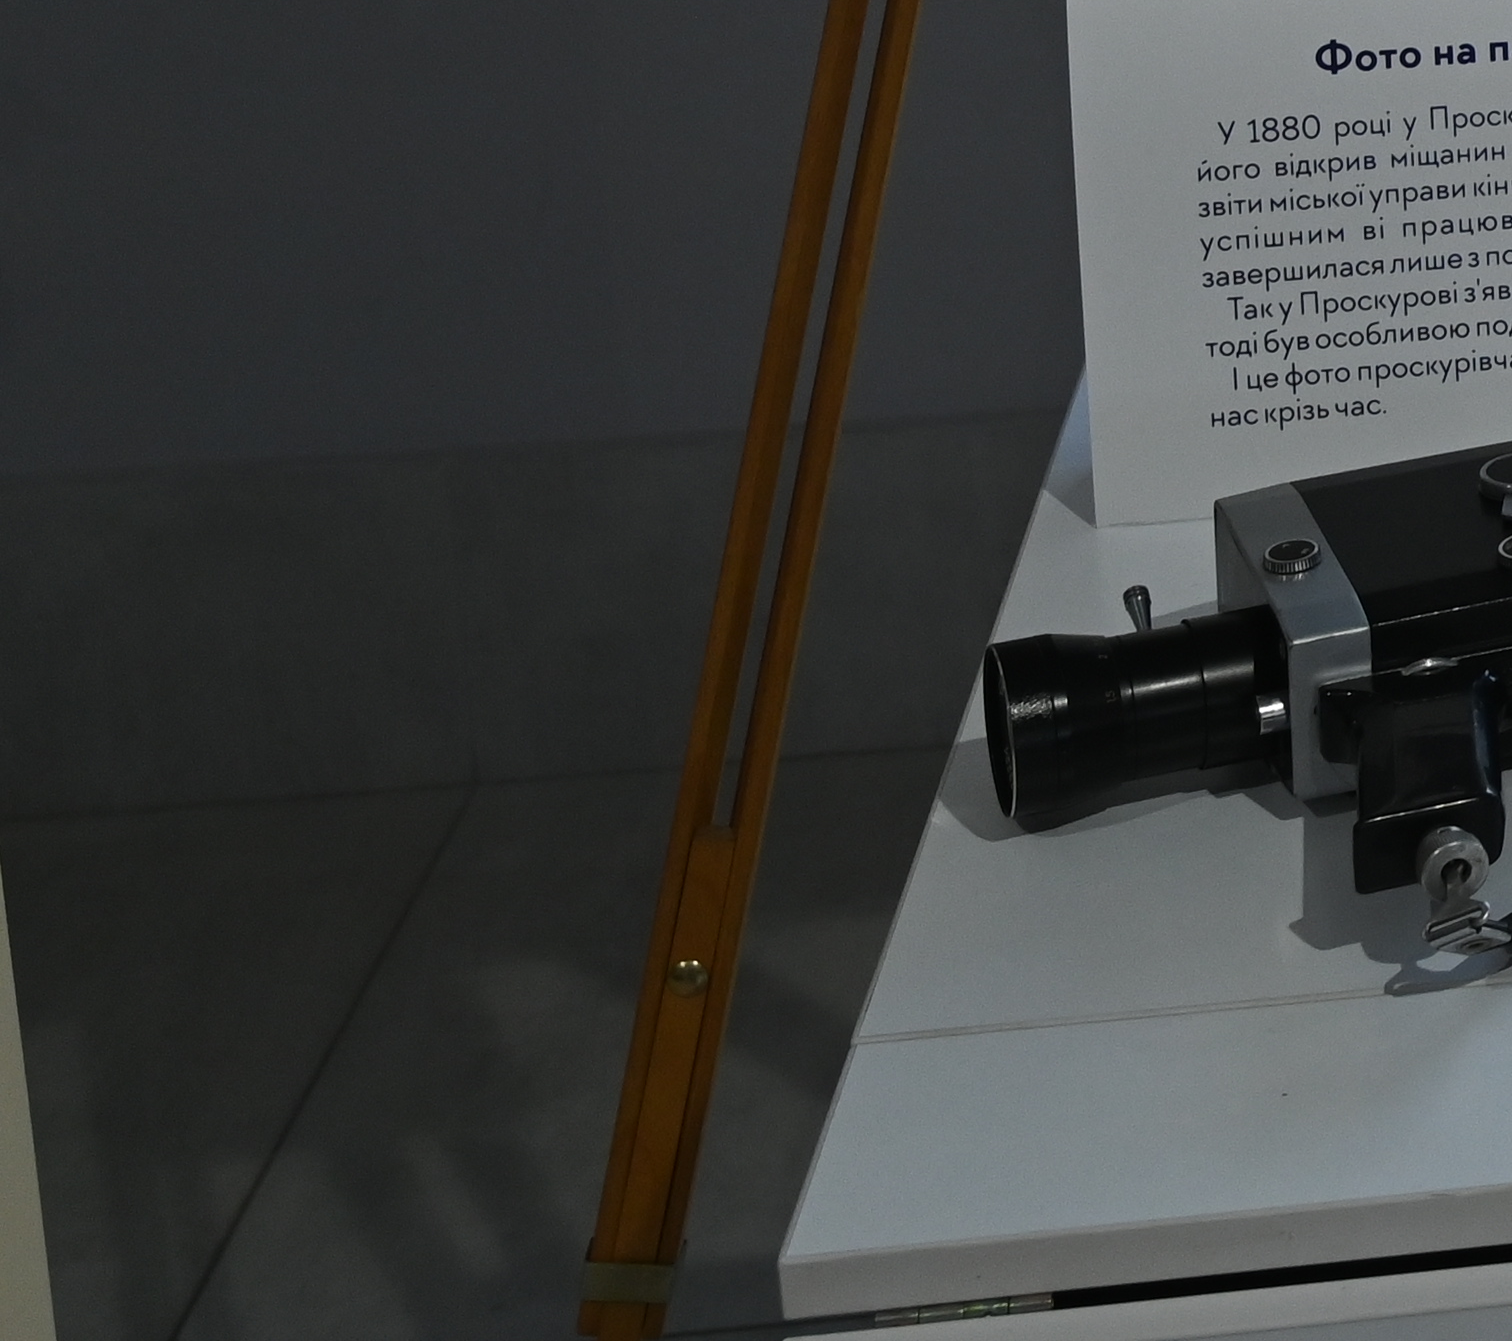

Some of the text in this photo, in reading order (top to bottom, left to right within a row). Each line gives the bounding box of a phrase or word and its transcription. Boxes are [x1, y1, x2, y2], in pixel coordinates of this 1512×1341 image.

[1315, 38, 1421, 75] Фото
[1433, 43, 1476, 66] на
[1217, 120, 1235, 145] У
[1247, 114, 1321, 143] 1880
[1334, 110, 1391, 146] році
[1402, 116, 1416, 141] у
[1197, 159, 1260, 182] його
[1275, 152, 1377, 182] відкрив
[1390, 143, 1505, 168] міщанин
[1198, 192, 1262, 218] звіти
[1269, 183, 1365, 212] міської
[1368, 183, 1466, 213] управи
